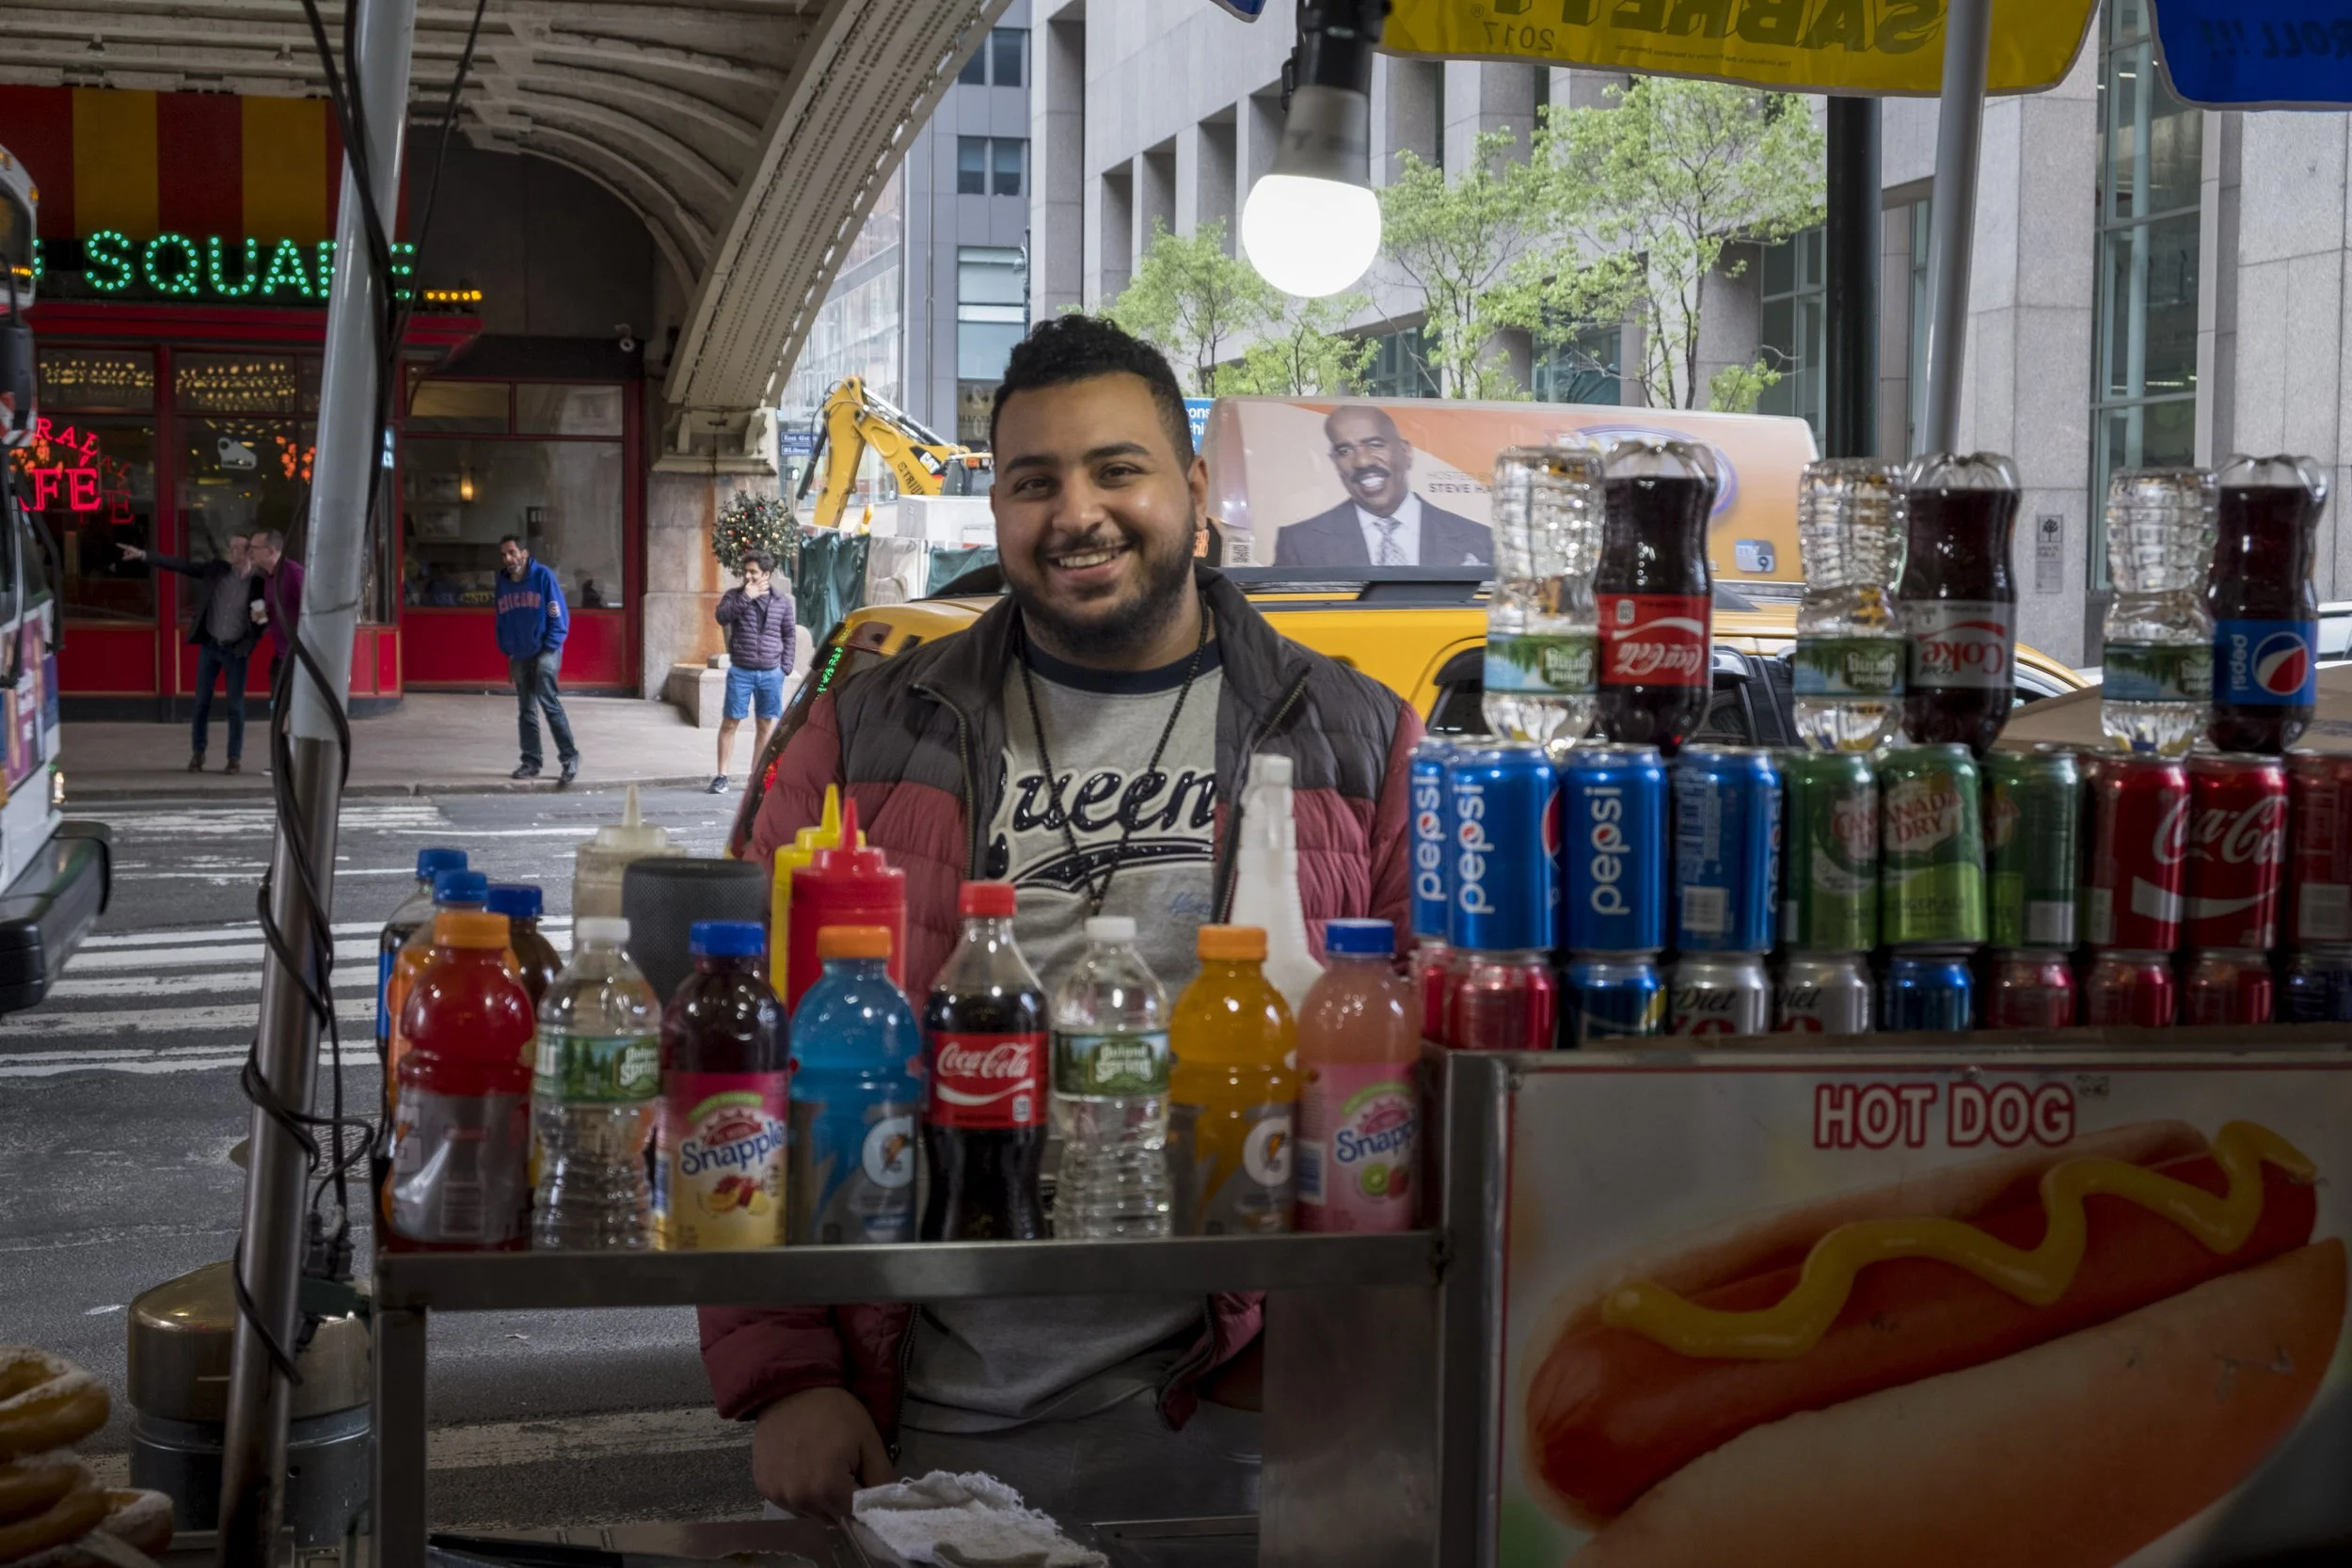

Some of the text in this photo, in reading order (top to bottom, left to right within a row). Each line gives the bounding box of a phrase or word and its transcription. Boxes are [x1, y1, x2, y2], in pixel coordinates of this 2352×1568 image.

[34, 417, 98, 455] RAL
[19, 455, 102, 513] FÉ
[1429, 483, 1471, 493] STEVE
[1922, 641, 2004, 675] Coke
[2230, 634, 2247, 690] pepsi
[990, 750, 1216, 837] ueen
[1417, 775, 1447, 901] pepsi
[1458, 784, 1494, 914] pepsi
[1585, 787, 1630, 914] pepsi
[1896, 816, 1942, 843] DRY
[1678, 988, 1737, 1012] Diet
[937, 1042, 1034, 1078] Coca-Cola
[1336, 1108, 1417, 1163] Snapp
[1815, 1082, 2075, 1148] HOT DOG
[680, 1119, 786, 1175] Snapple
